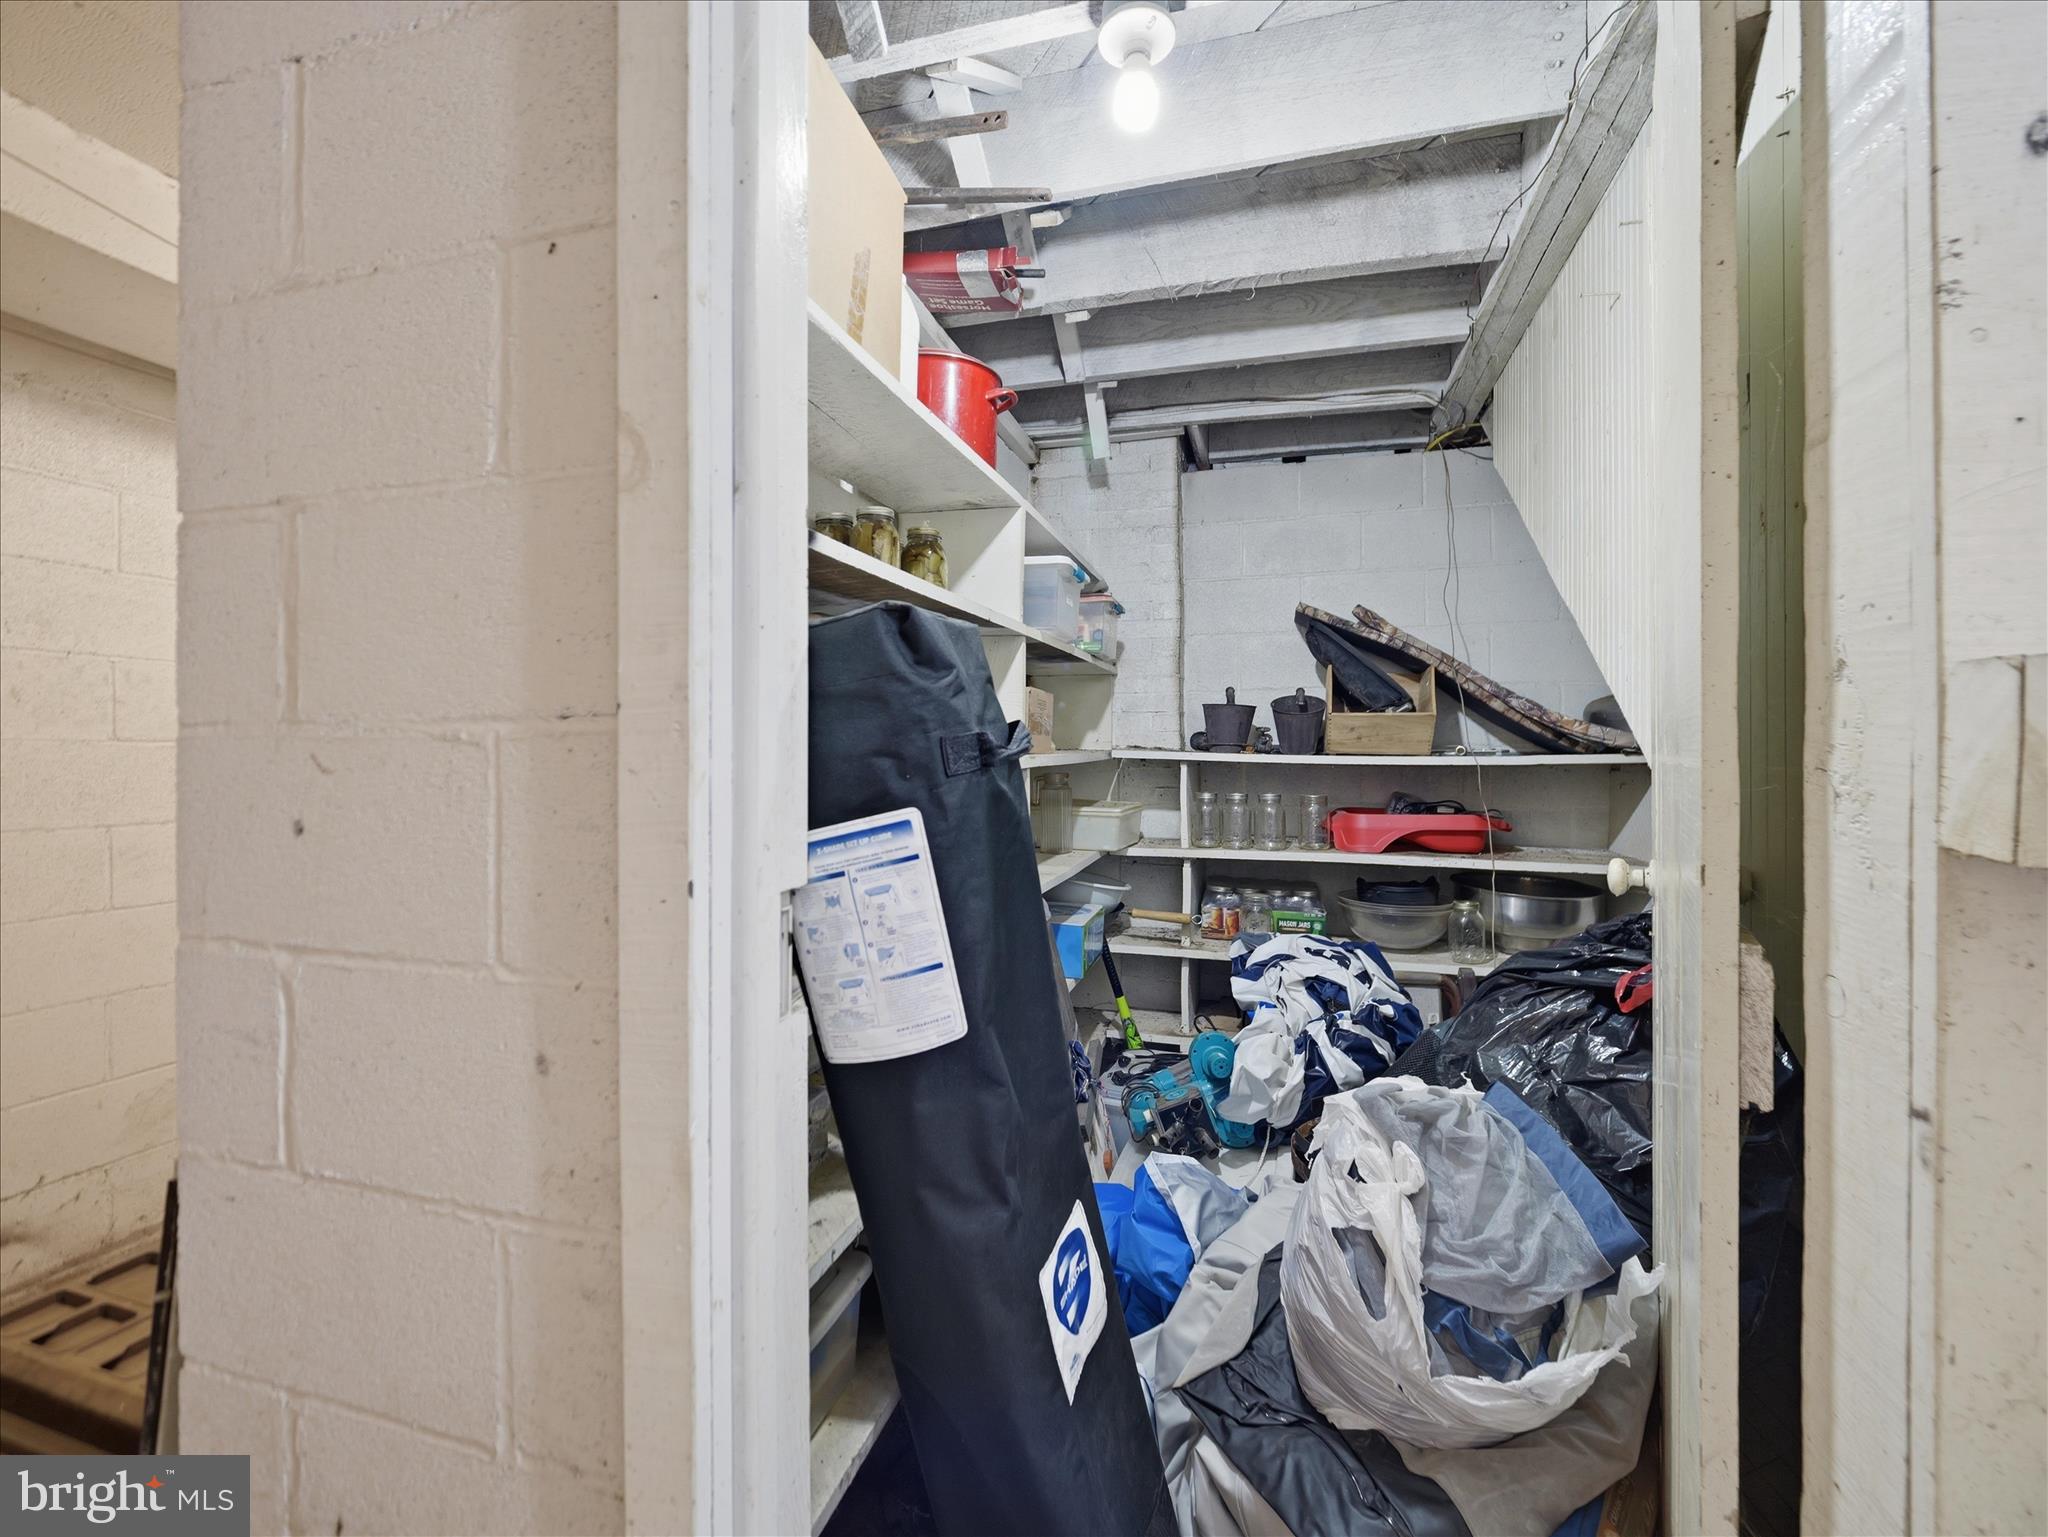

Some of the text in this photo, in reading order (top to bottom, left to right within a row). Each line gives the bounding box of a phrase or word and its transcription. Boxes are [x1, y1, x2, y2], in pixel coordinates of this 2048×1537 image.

[948, 298, 984, 306] Game
[1278, 920, 1311, 929] MASON JARS
